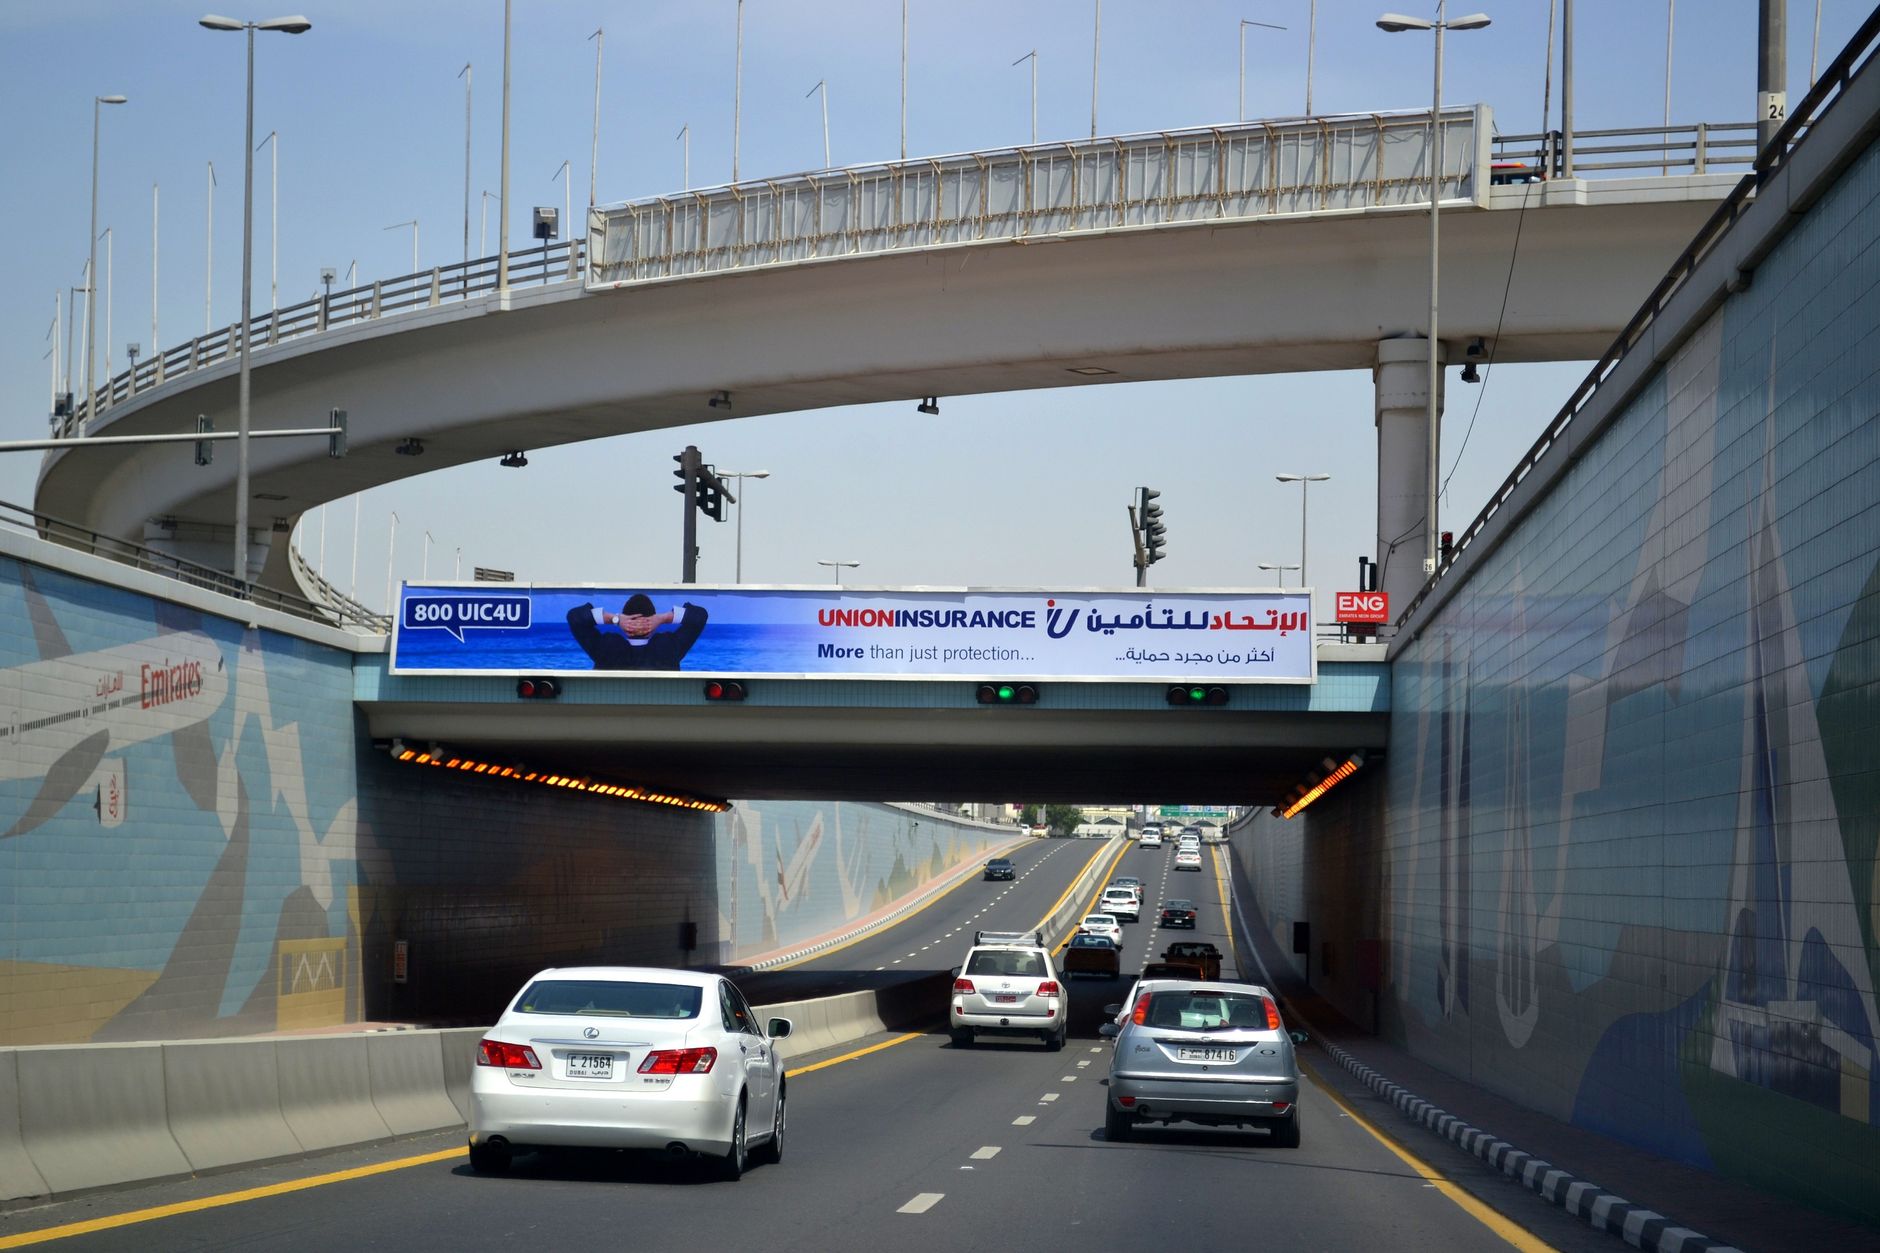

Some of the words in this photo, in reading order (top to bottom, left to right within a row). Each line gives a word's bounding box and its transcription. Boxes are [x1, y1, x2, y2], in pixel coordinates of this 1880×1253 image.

[1769, 104, 1784, 119] 24
[1339, 595, 1385, 611] ENG
[414, 603, 453, 622] 800
[457, 603, 521, 622] UIC4U
[817, 643, 864, 659] More
[870, 644, 904, 660] than
[909, 645, 938, 663] just
[1174, 653, 1213, 666] مجرد
[1218, 648, 1241, 663] من
[1245, 647, 1275, 664] أكثر
[141, 656, 202, 710] Emirates
[1180, 1048, 1186, 1058] F
[1204, 1049, 1235, 1060] 87416
